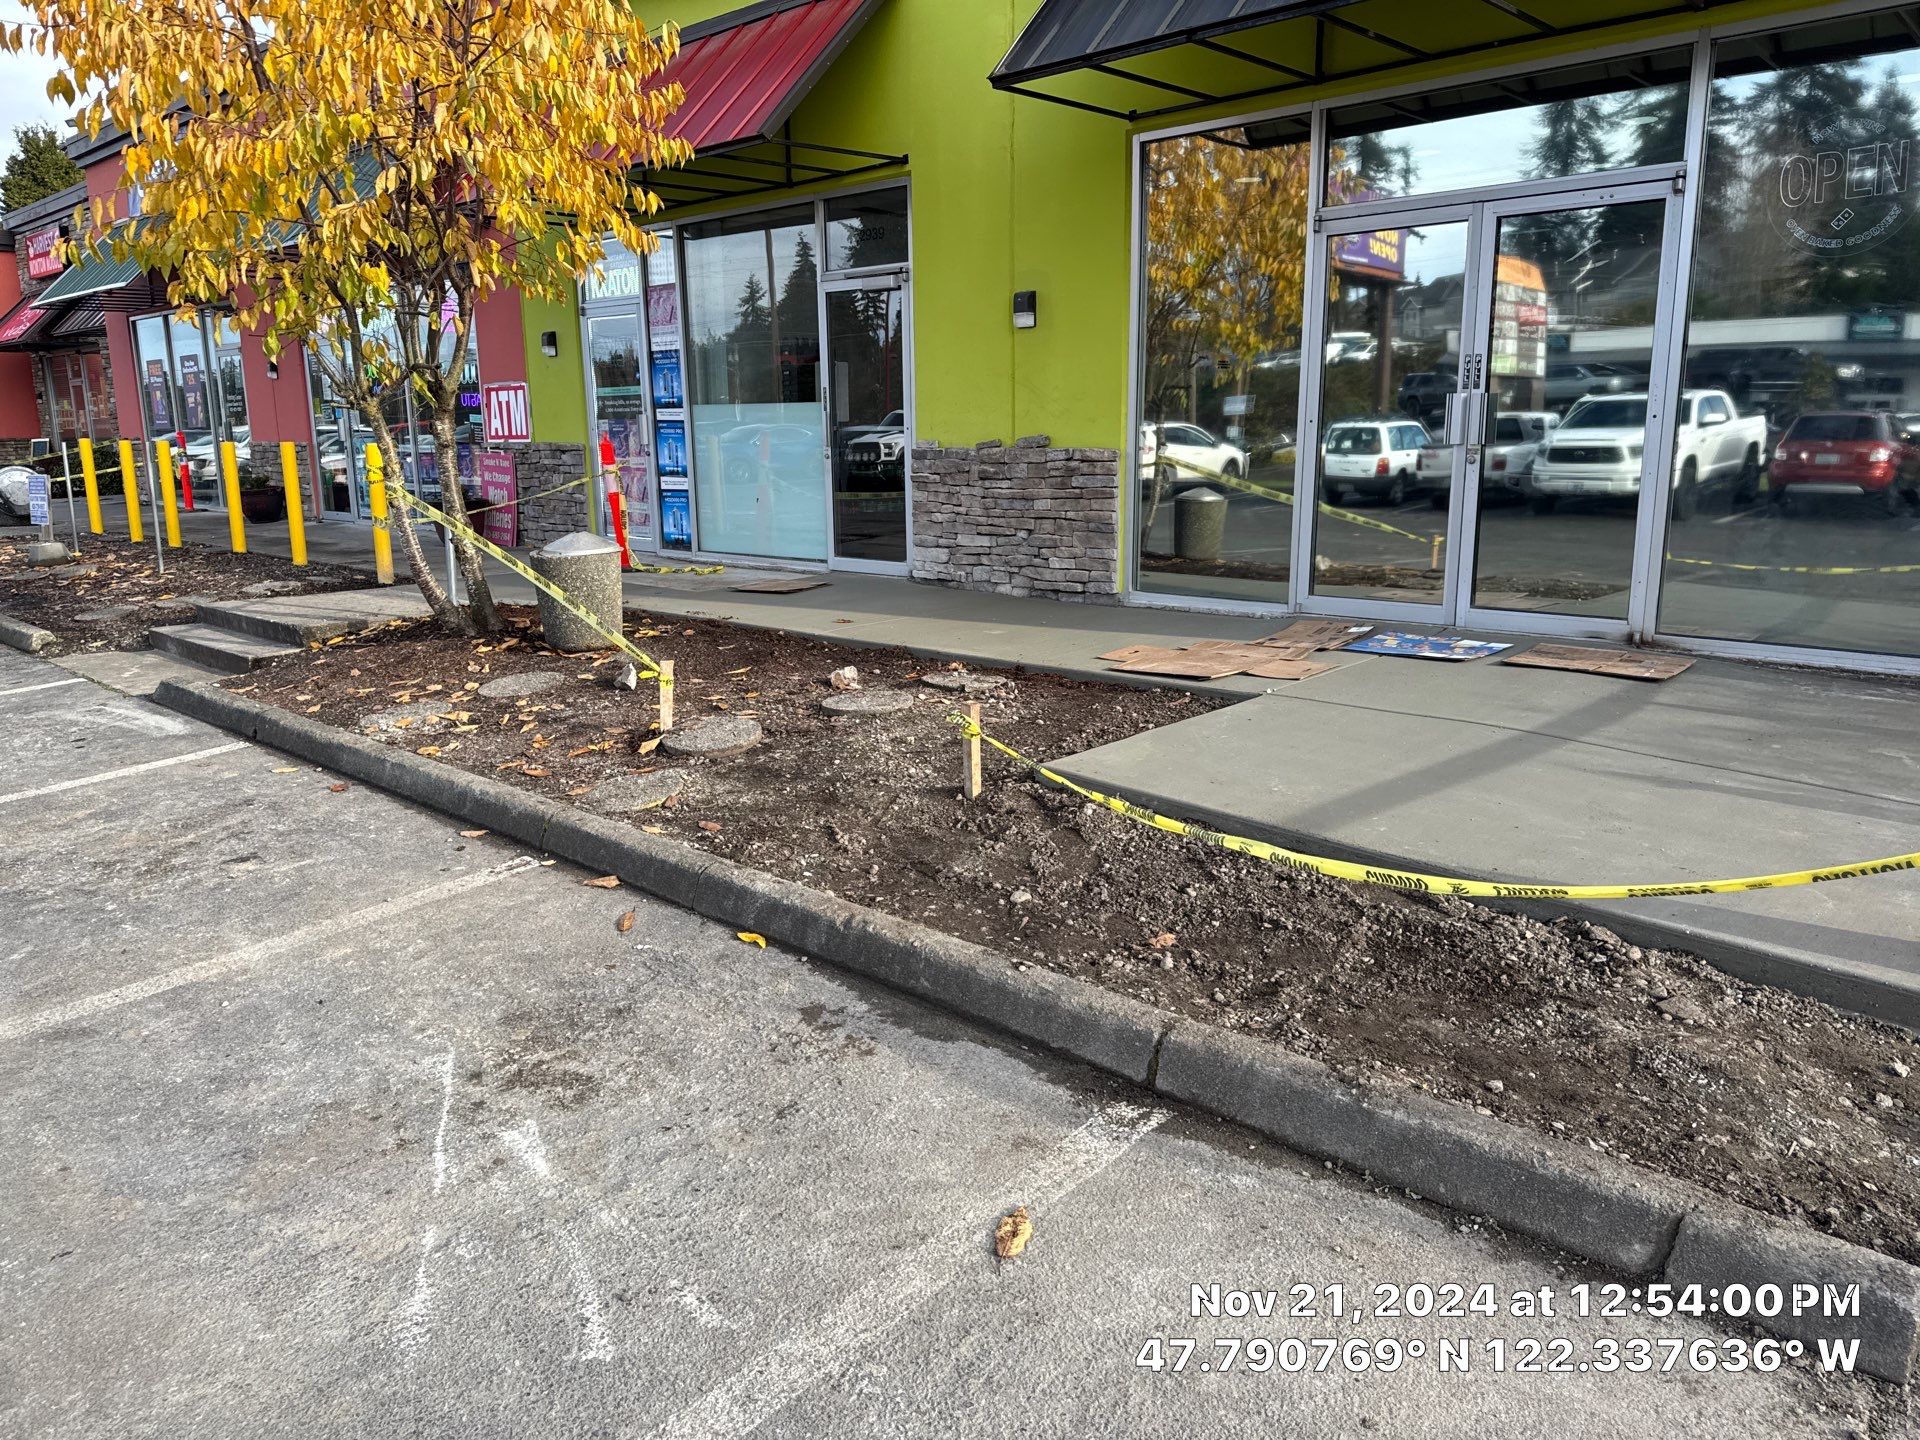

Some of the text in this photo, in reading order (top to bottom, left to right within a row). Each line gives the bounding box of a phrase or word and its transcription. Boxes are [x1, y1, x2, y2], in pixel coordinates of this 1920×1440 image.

[1780, 139, 1910, 207] OPEN
[1786, 205, 1903, 248] OVEN BAKED GOODNESS
[490, 389, 527, 436] ATM
[484, 471, 511, 484] We Change
[488, 486, 508, 504] Watch
